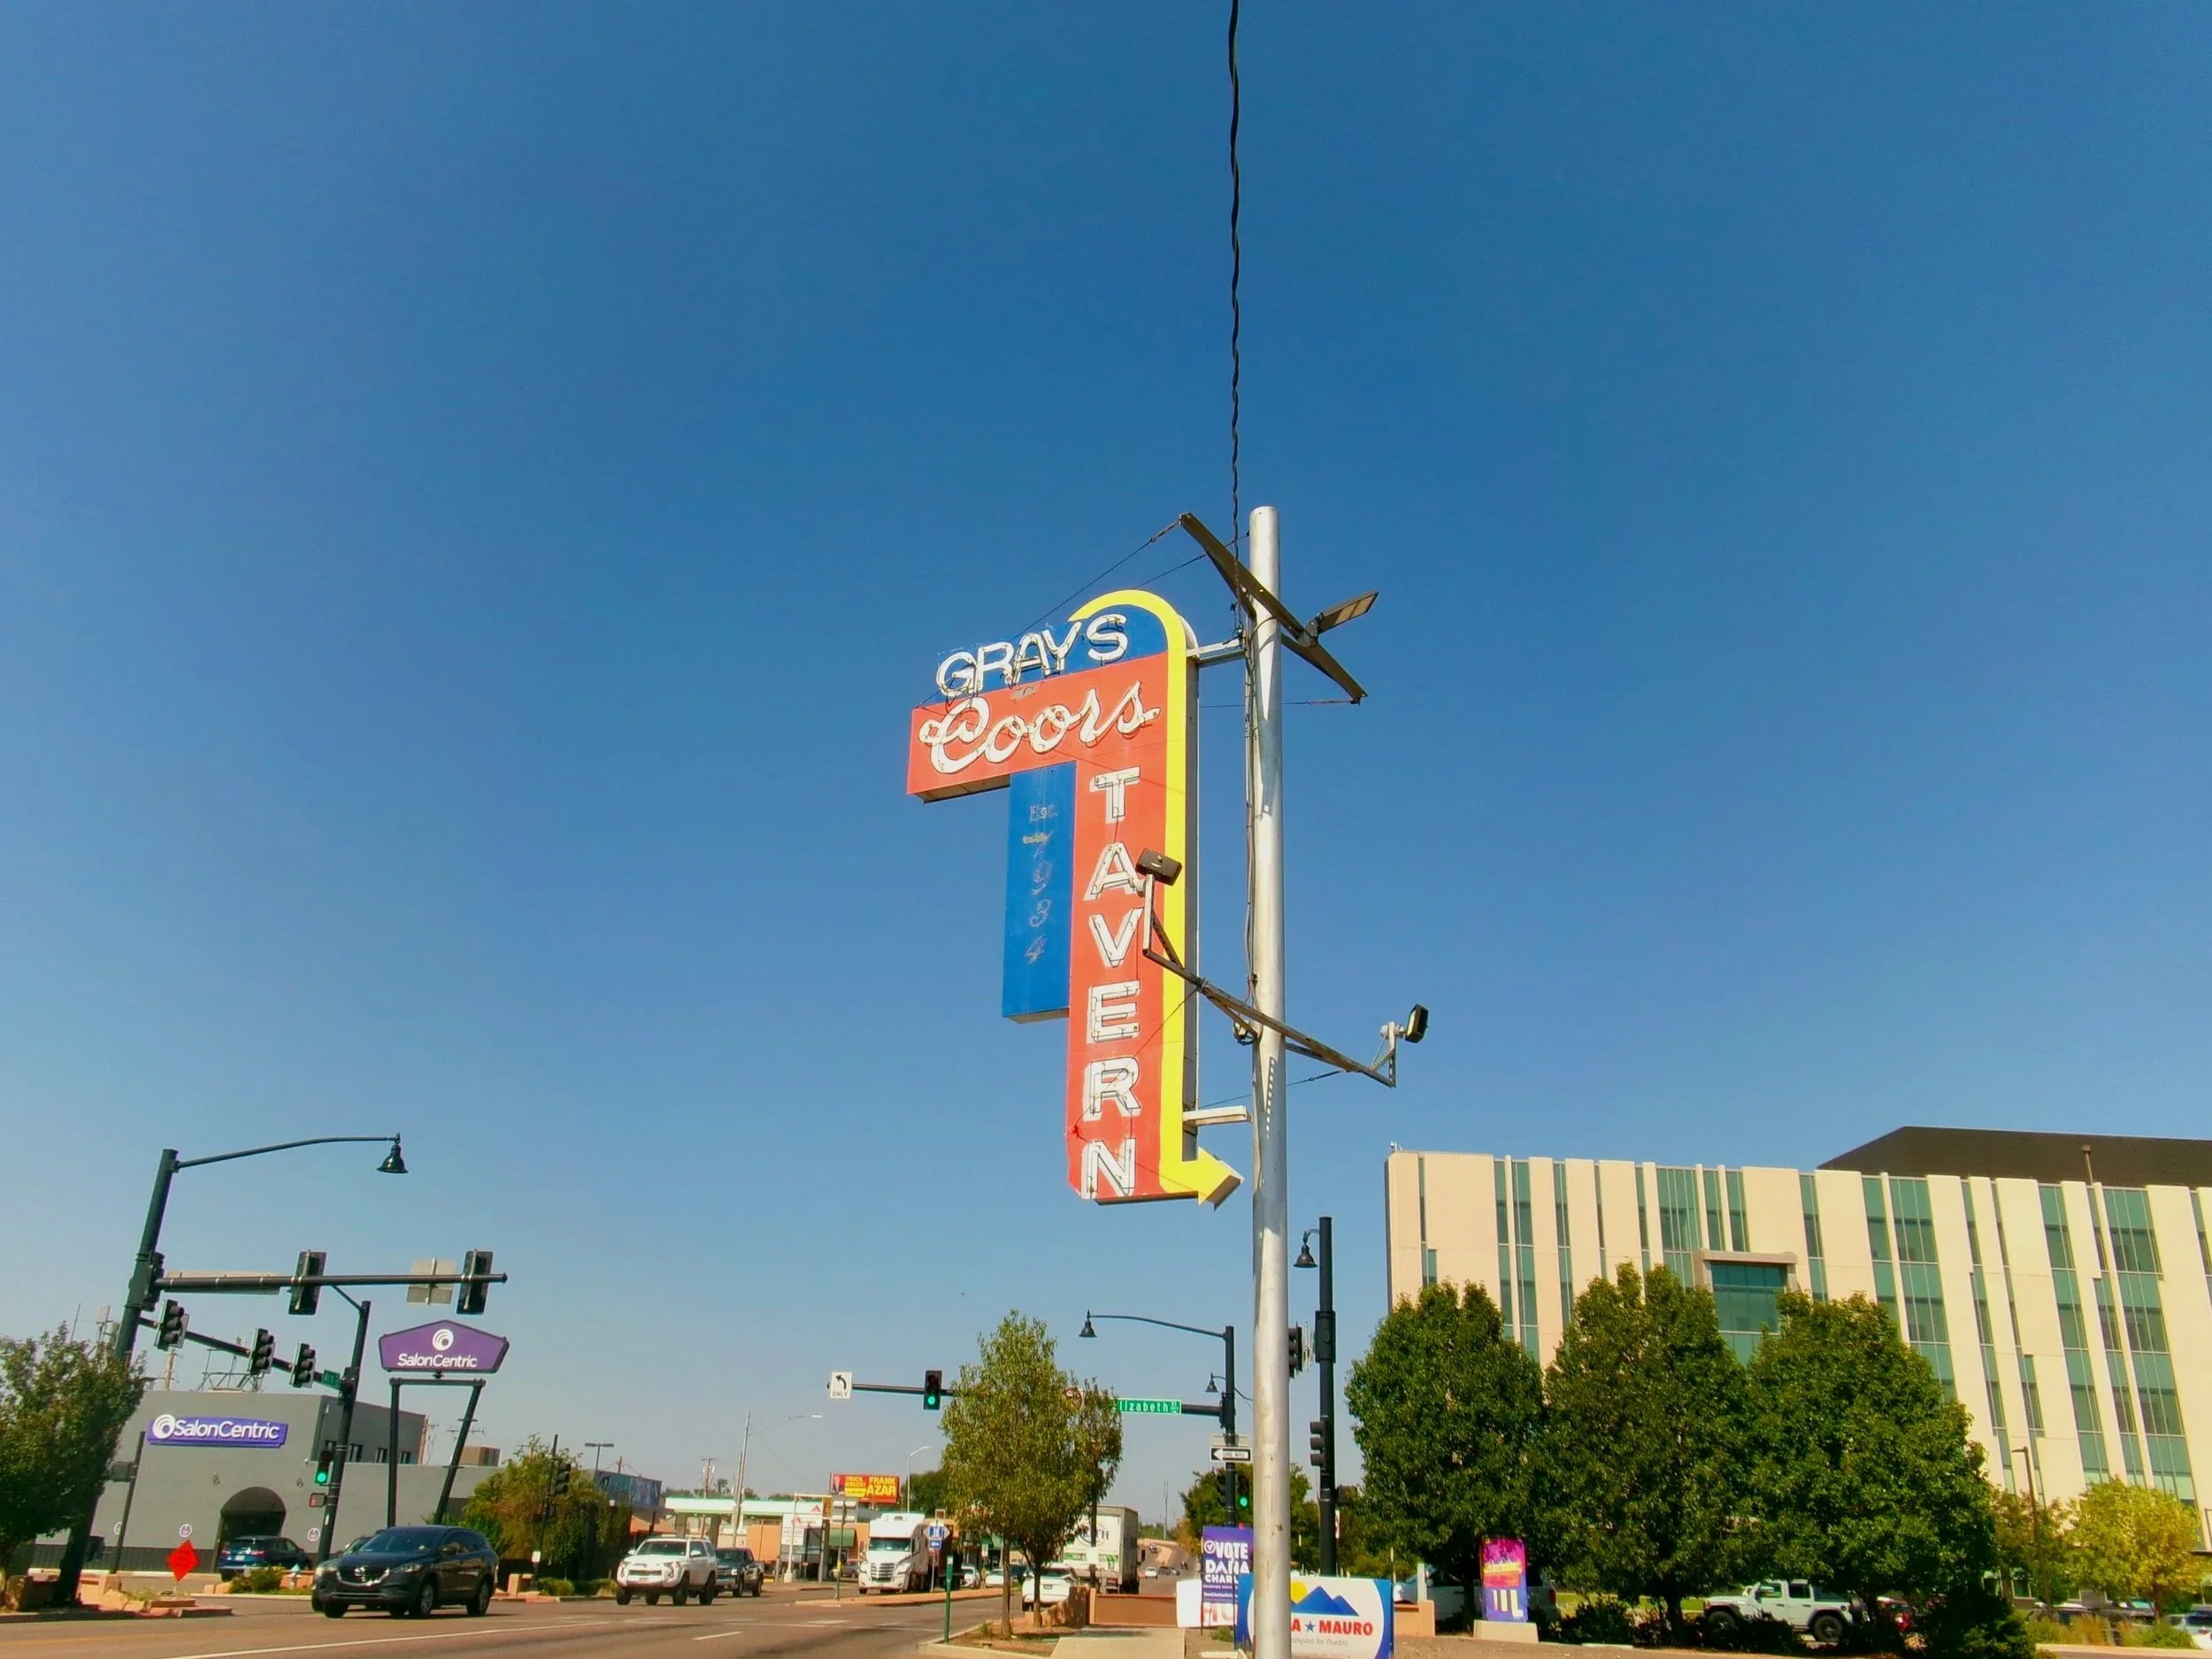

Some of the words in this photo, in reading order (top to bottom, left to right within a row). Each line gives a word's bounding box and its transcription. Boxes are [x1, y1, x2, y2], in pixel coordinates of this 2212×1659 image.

[918, 680, 1161, 774] Coors
[1080, 765, 1145, 1200] TAVERN
[397, 1353, 478, 1368] SalonCentric
[1112, 1400, 1169, 1412] lizabeth
[173, 1419, 280, 1439] SalonCentric
[869, 1477, 895, 1486] FRANK
[866, 1485, 896, 1496] AZAR
[1216, 1542, 1248, 1560] VOTE
[1205, 1560, 1250, 1574] DANA
[1204, 1574, 1239, 1585] CHARL
[1318, 1620, 1373, 1636] MAURO
